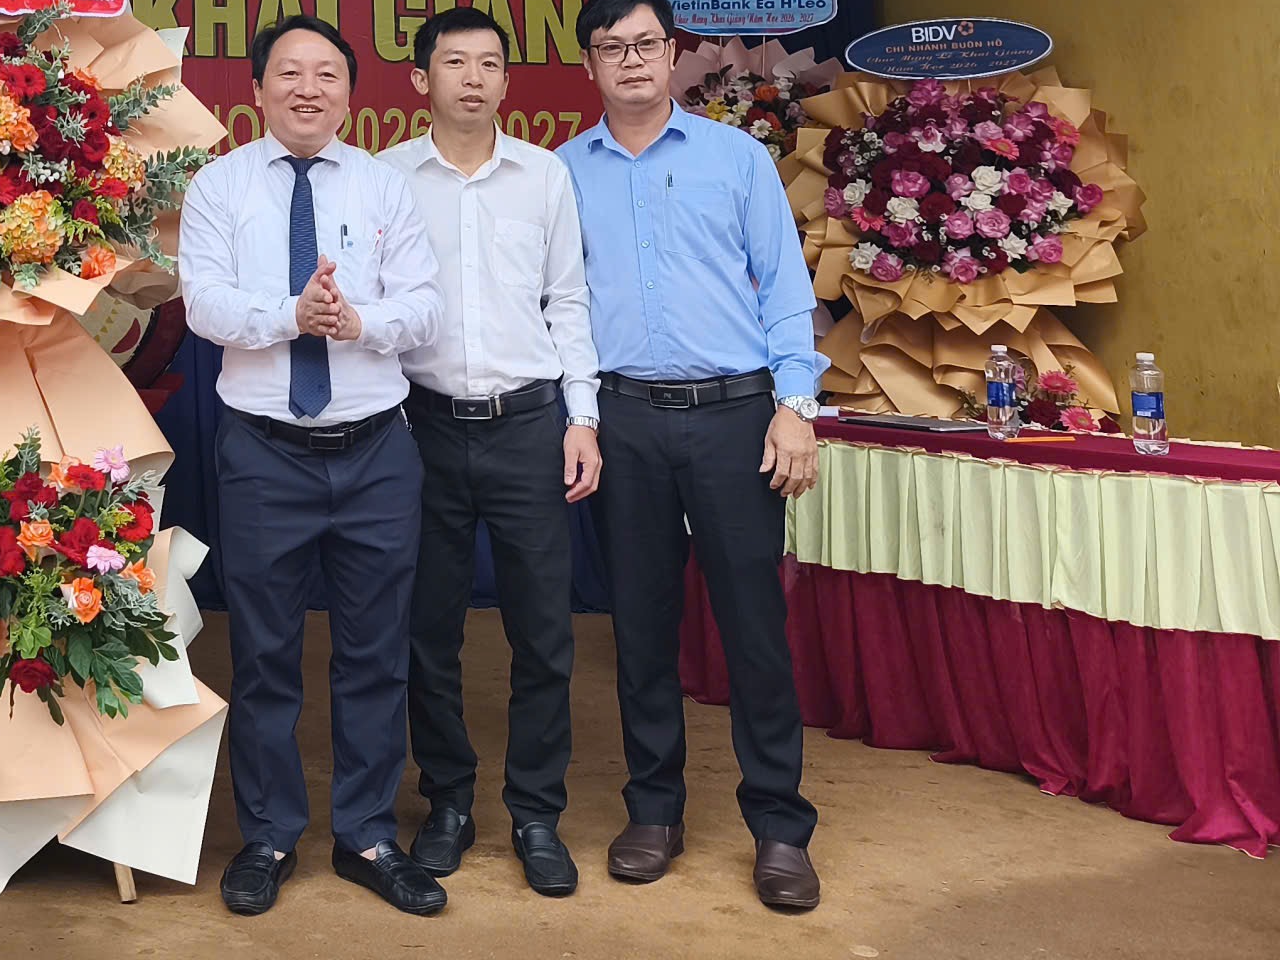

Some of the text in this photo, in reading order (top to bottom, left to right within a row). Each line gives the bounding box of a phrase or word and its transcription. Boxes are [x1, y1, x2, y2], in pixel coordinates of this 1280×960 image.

[756, 0, 774, 9] Ea
[912, 25, 957, 43] BIDV
[494, 110, 582, 150] 027
